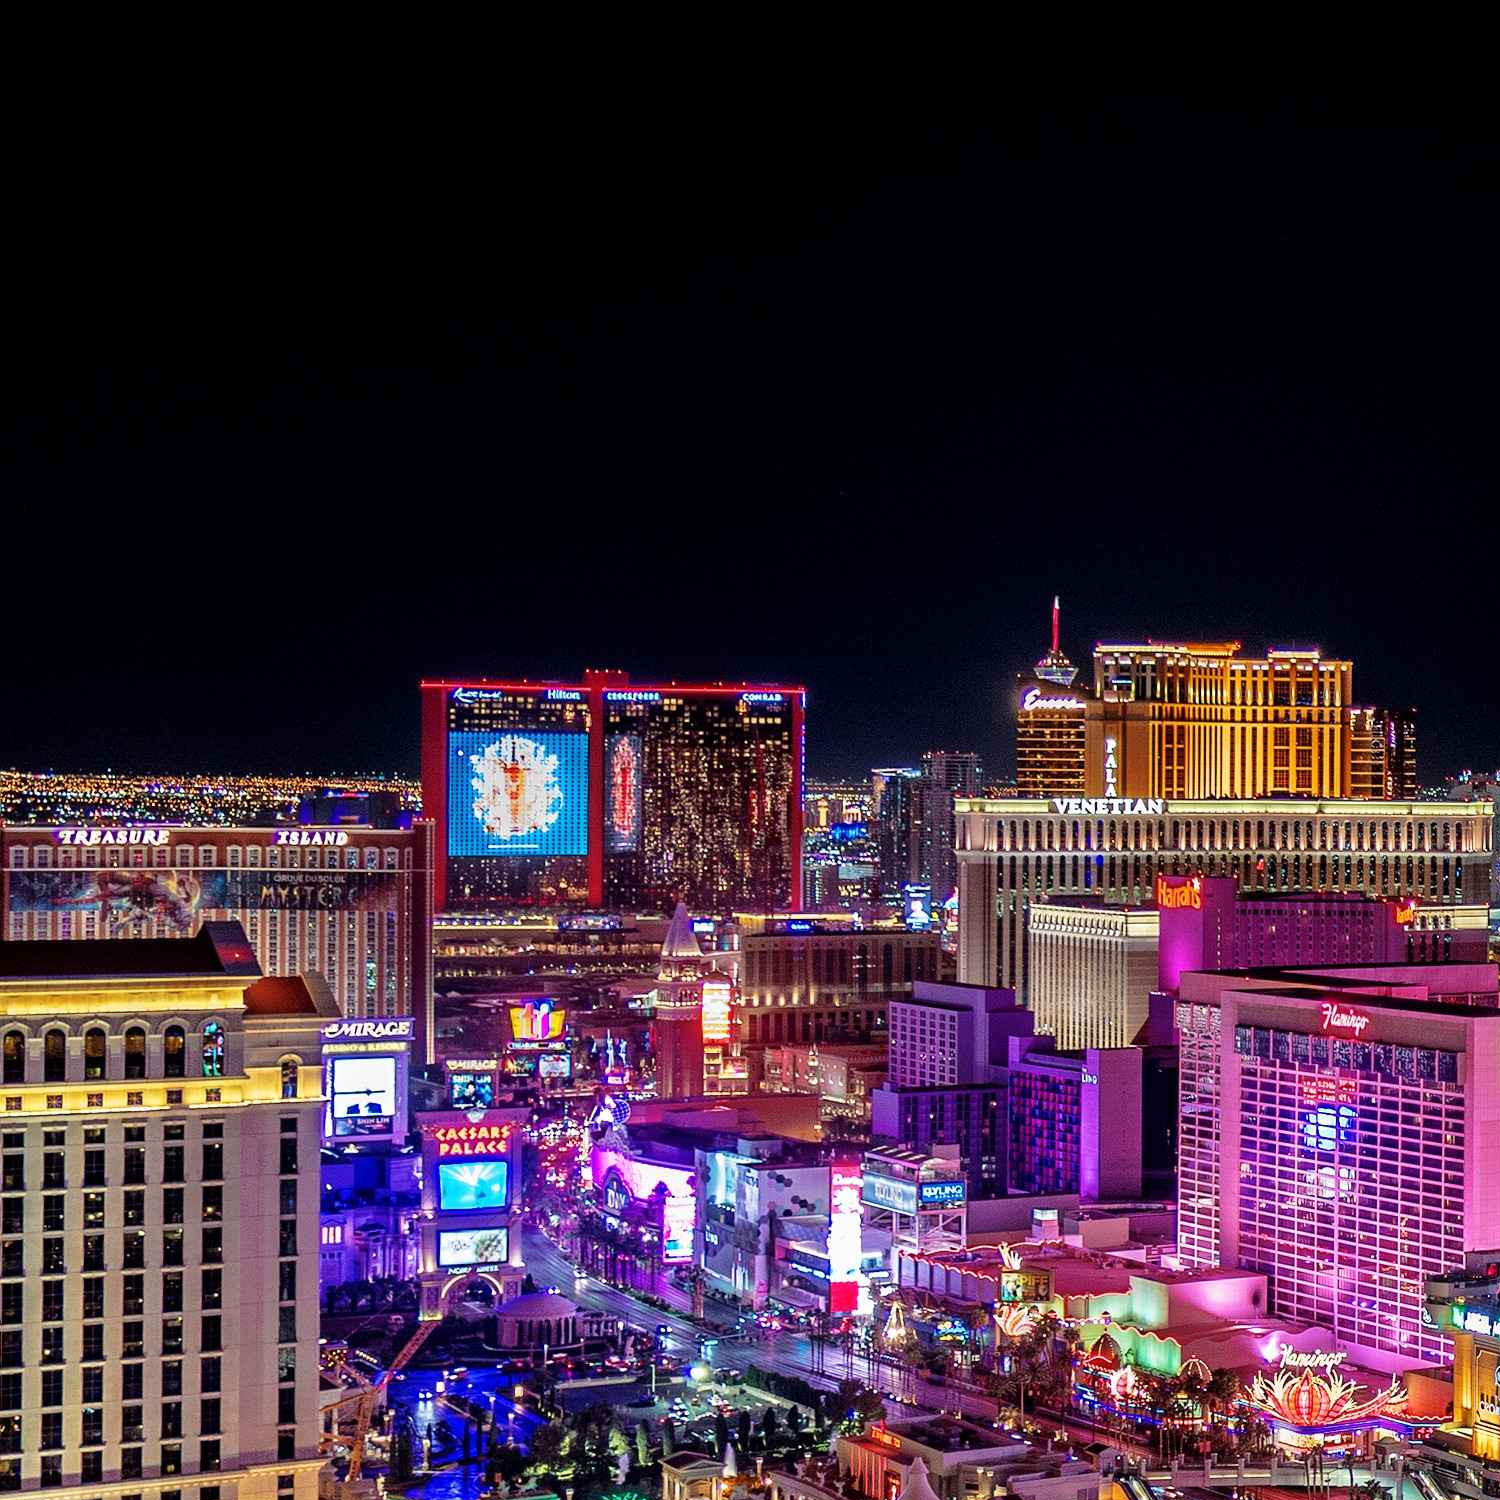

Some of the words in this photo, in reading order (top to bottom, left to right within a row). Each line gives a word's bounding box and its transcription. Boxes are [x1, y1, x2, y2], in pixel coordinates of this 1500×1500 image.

[548, 690, 581, 700] Hilton
[1053, 798, 1163, 815] VENETIAN
[58, 829, 170, 846] TREASURE
[277, 830, 349, 846] ISLAND
[1321, 1003, 1369, 1036] Flamingo
[330, 1021, 410, 1038] MIRAGE
[434, 1125, 512, 1141] CAESARS
[438, 1140, 508, 1156] PALACE
[1280, 1343, 1347, 1375] Flamingo
